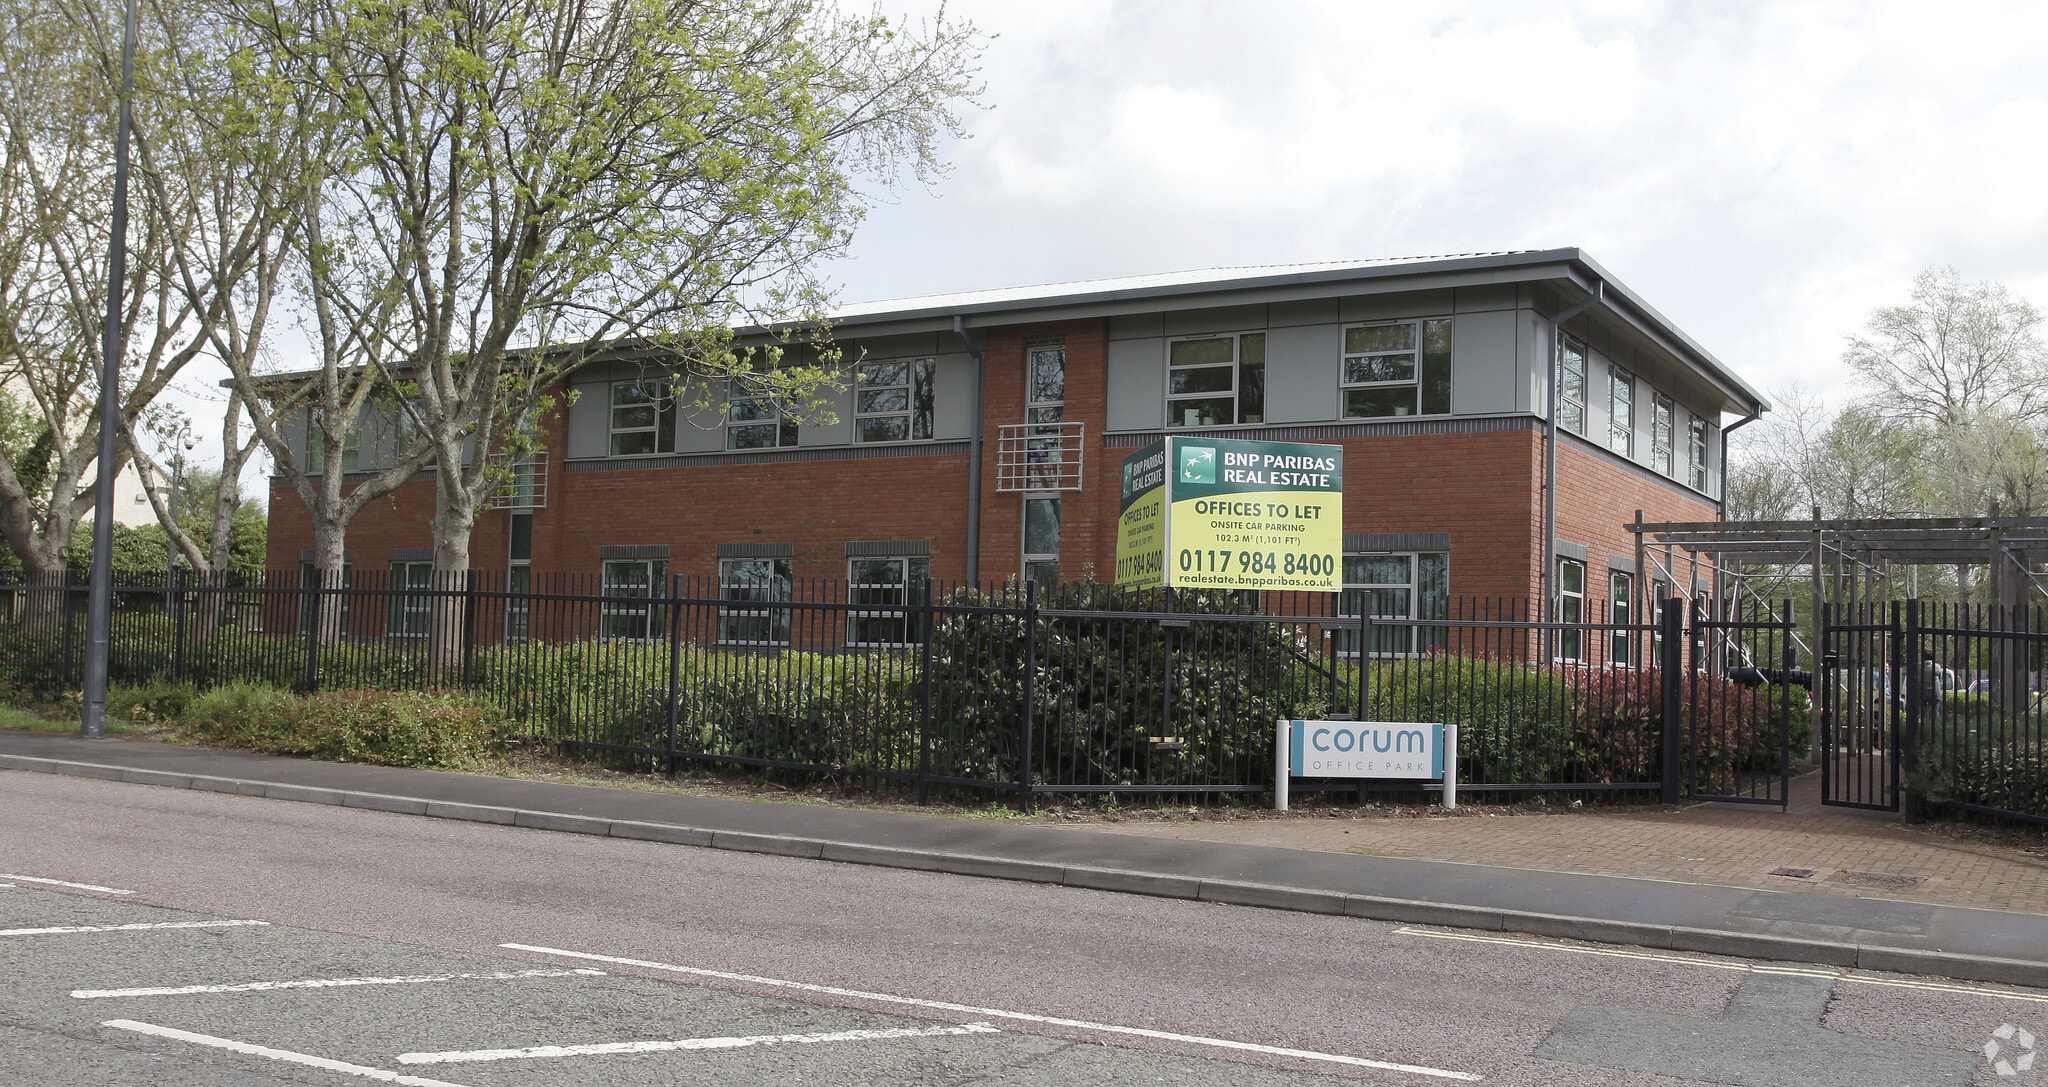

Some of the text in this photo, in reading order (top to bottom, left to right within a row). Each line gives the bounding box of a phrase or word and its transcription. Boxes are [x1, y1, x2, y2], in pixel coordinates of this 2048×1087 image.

[1133, 451, 1164, 476] BNP PARIBAS
[1224, 452, 1335, 471] BNP PARIBAS
[1132, 469, 1162, 492] REAL ESTATE
[1224, 470, 1330, 487] REAL ESTATE
[1124, 502, 1159, 525] OFFICES TO LET
[1194, 501, 1321, 519] OFFICES TO LET
[1210, 521, 1305, 532] ONSITE CAR PARKING
[1215, 534, 1239, 542] 102.3
[1256, 536, 1282, 545] (1,101
[1118, 550, 1162, 579] 0117 984 8400
[1179, 549, 1334, 576] 0117 984 8400
[1179, 573, 1333, 587] realestate.bnpparibas.co.uk
[1312, 728, 1425, 753] corum
[1313, 761, 1424, 771] OFFICE PARK
